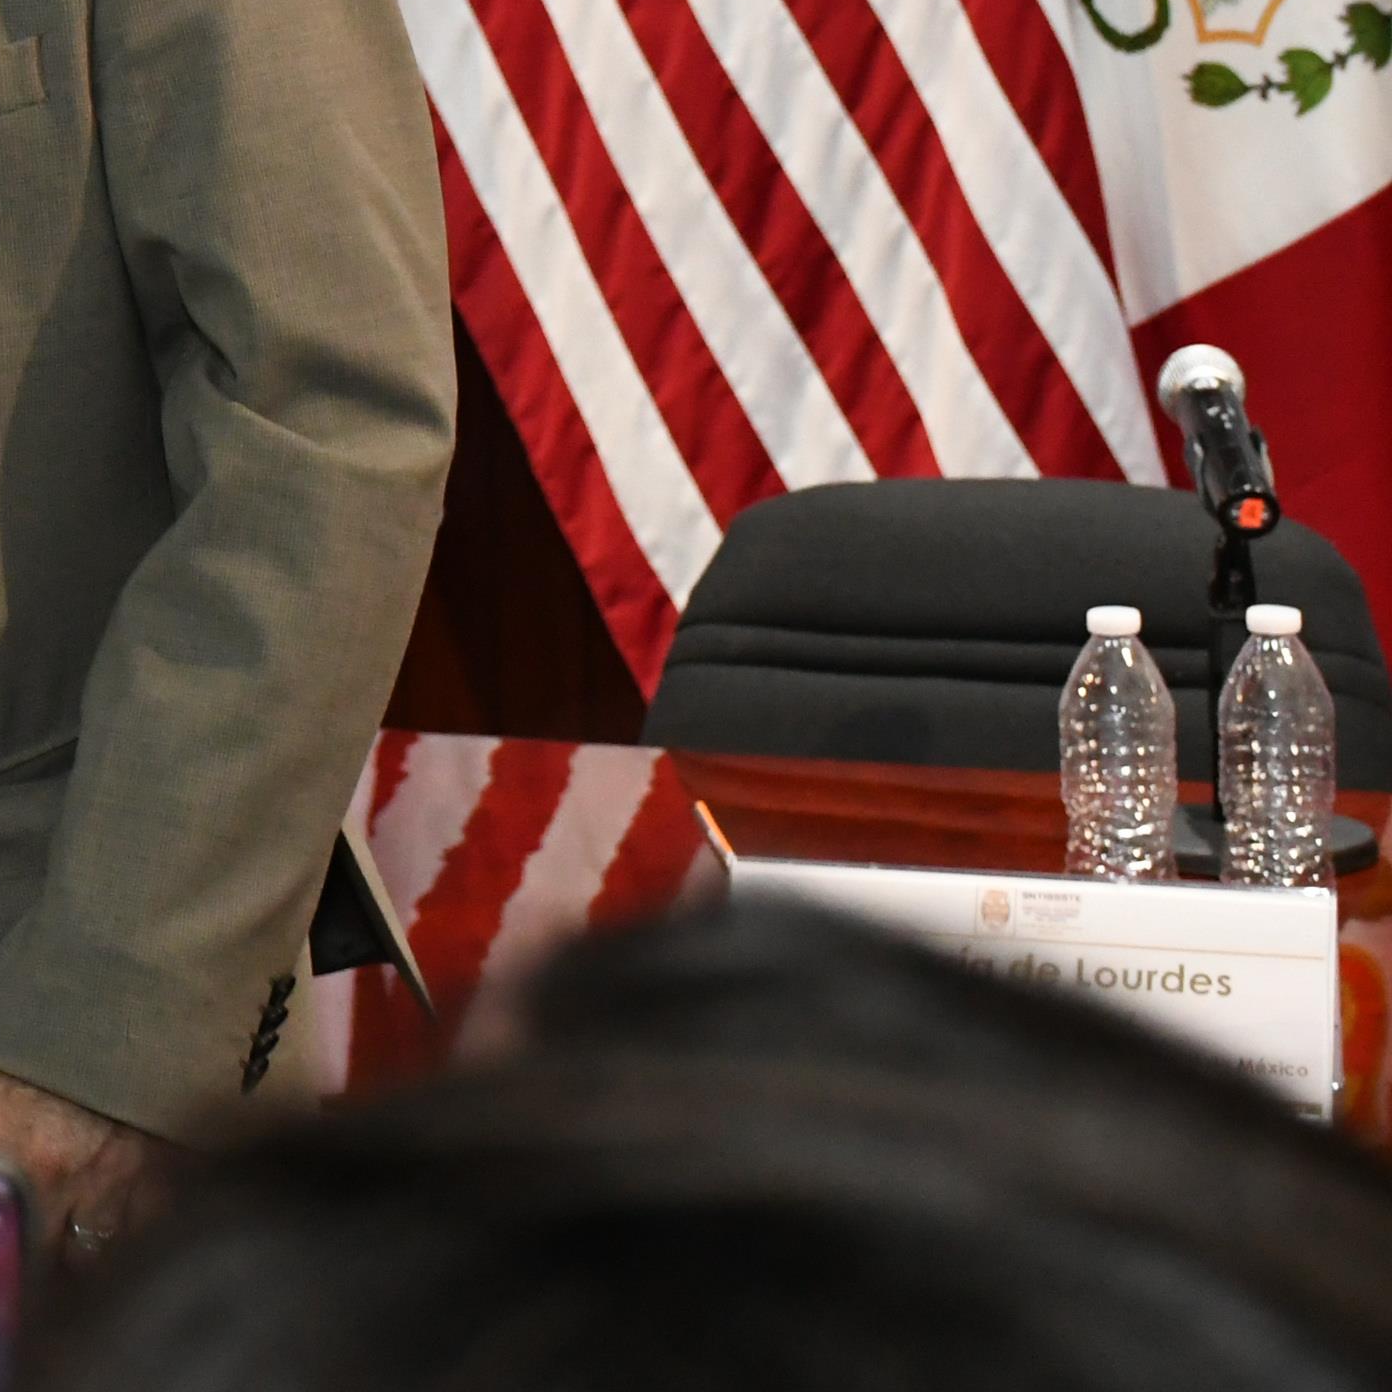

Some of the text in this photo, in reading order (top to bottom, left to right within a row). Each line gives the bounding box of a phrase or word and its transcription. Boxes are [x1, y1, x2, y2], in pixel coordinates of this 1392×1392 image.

[1009, 952, 1062, 986] de
[1076, 958, 1233, 997] Lourdes
[1238, 1055, 1309, 1079] México
